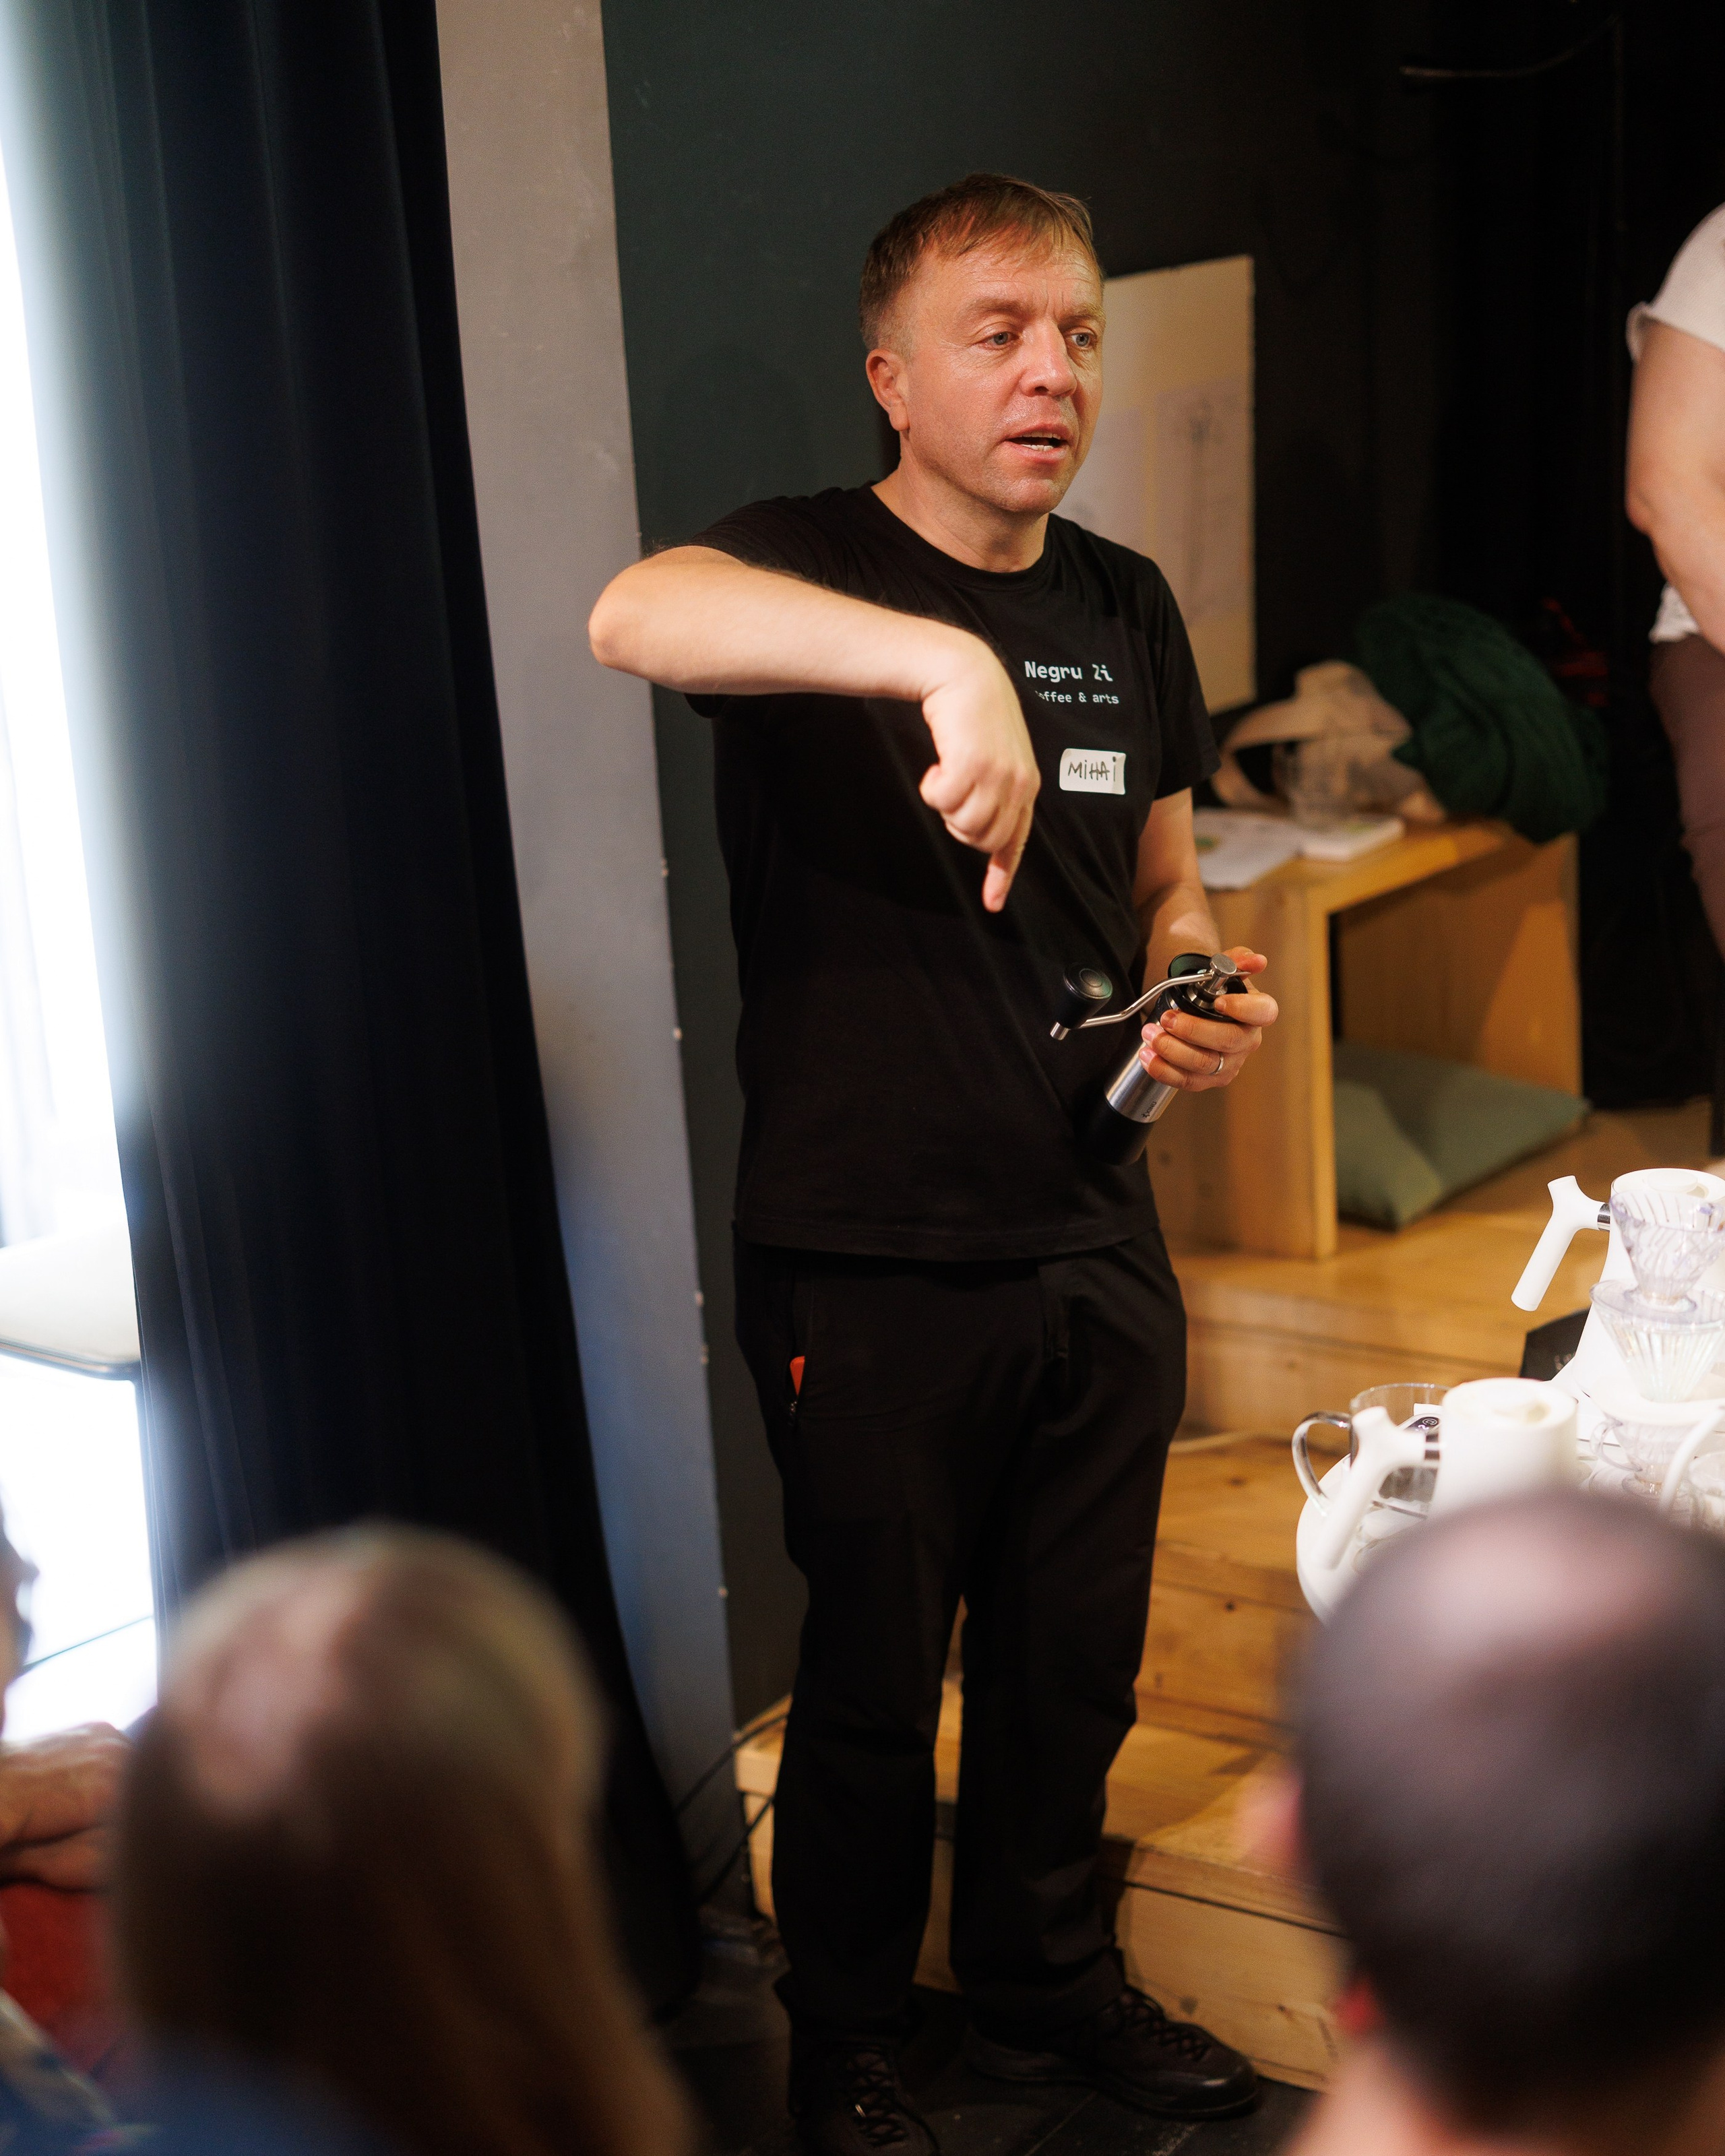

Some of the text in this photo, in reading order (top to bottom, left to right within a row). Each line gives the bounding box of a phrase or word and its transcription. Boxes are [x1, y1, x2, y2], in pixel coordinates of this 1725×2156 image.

[1024, 661, 1082, 683] Negru
[1035, 691, 1119, 704] offee & arts
